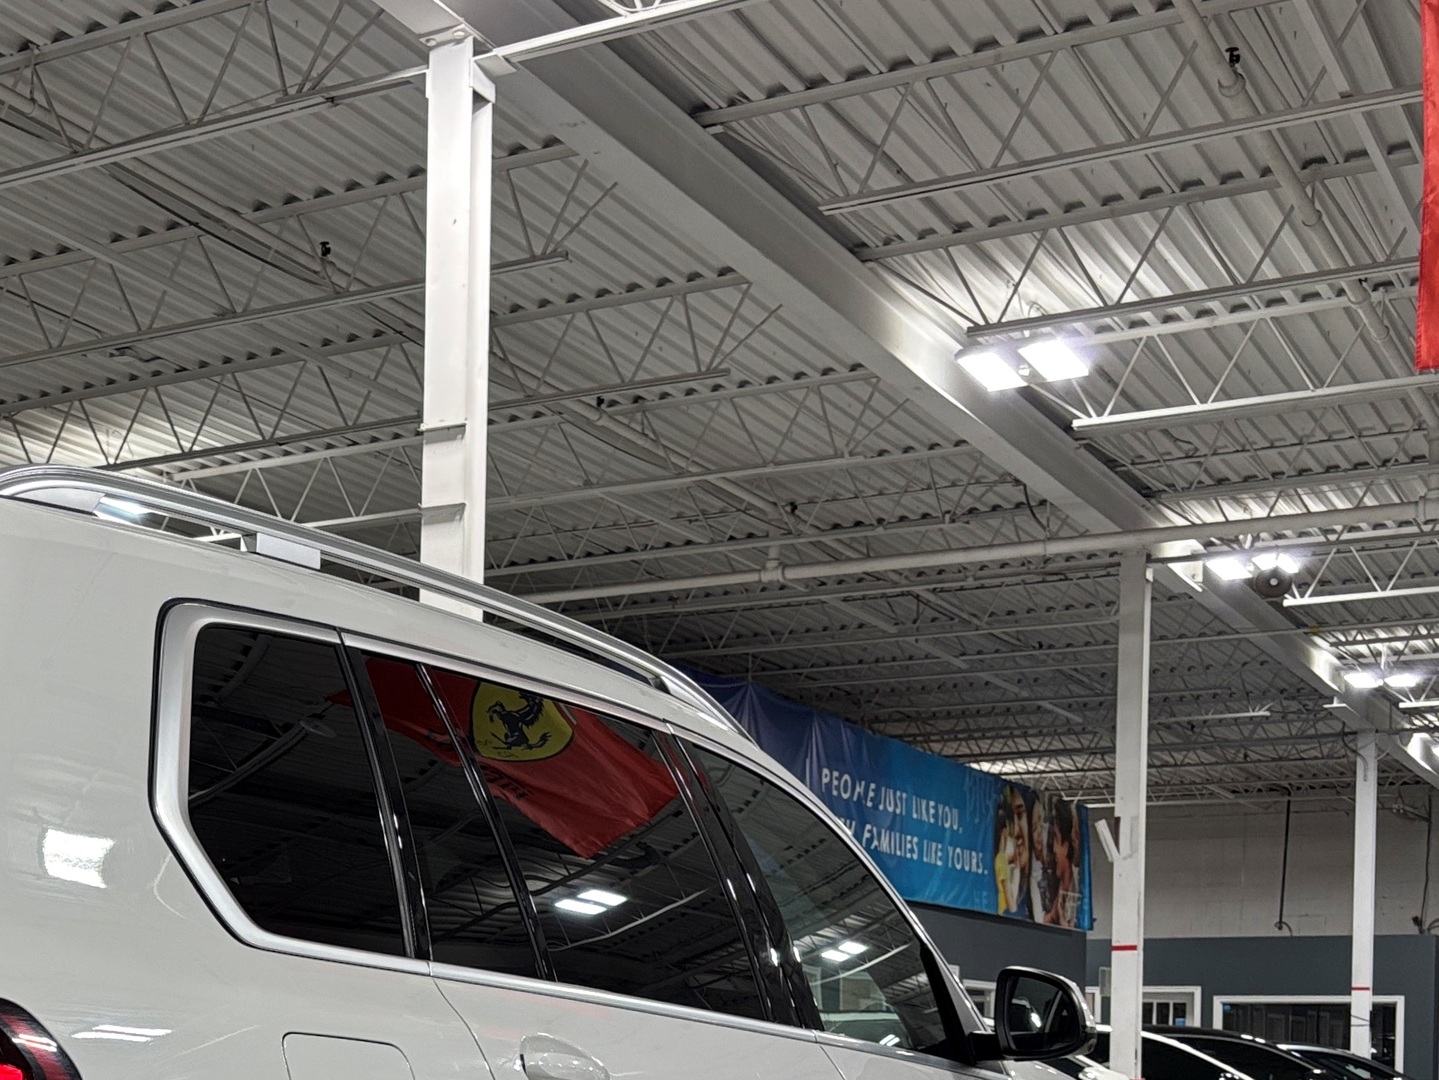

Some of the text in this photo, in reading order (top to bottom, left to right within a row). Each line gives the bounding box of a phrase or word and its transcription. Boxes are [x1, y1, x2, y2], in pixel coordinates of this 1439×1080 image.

[878, 785, 909, 816] JUST
[912, 794, 936, 824] LIKE
[862, 823, 919, 861] FAMILIES
[923, 838, 943, 867] LIKE
[947, 845, 989, 875] YOURS.
